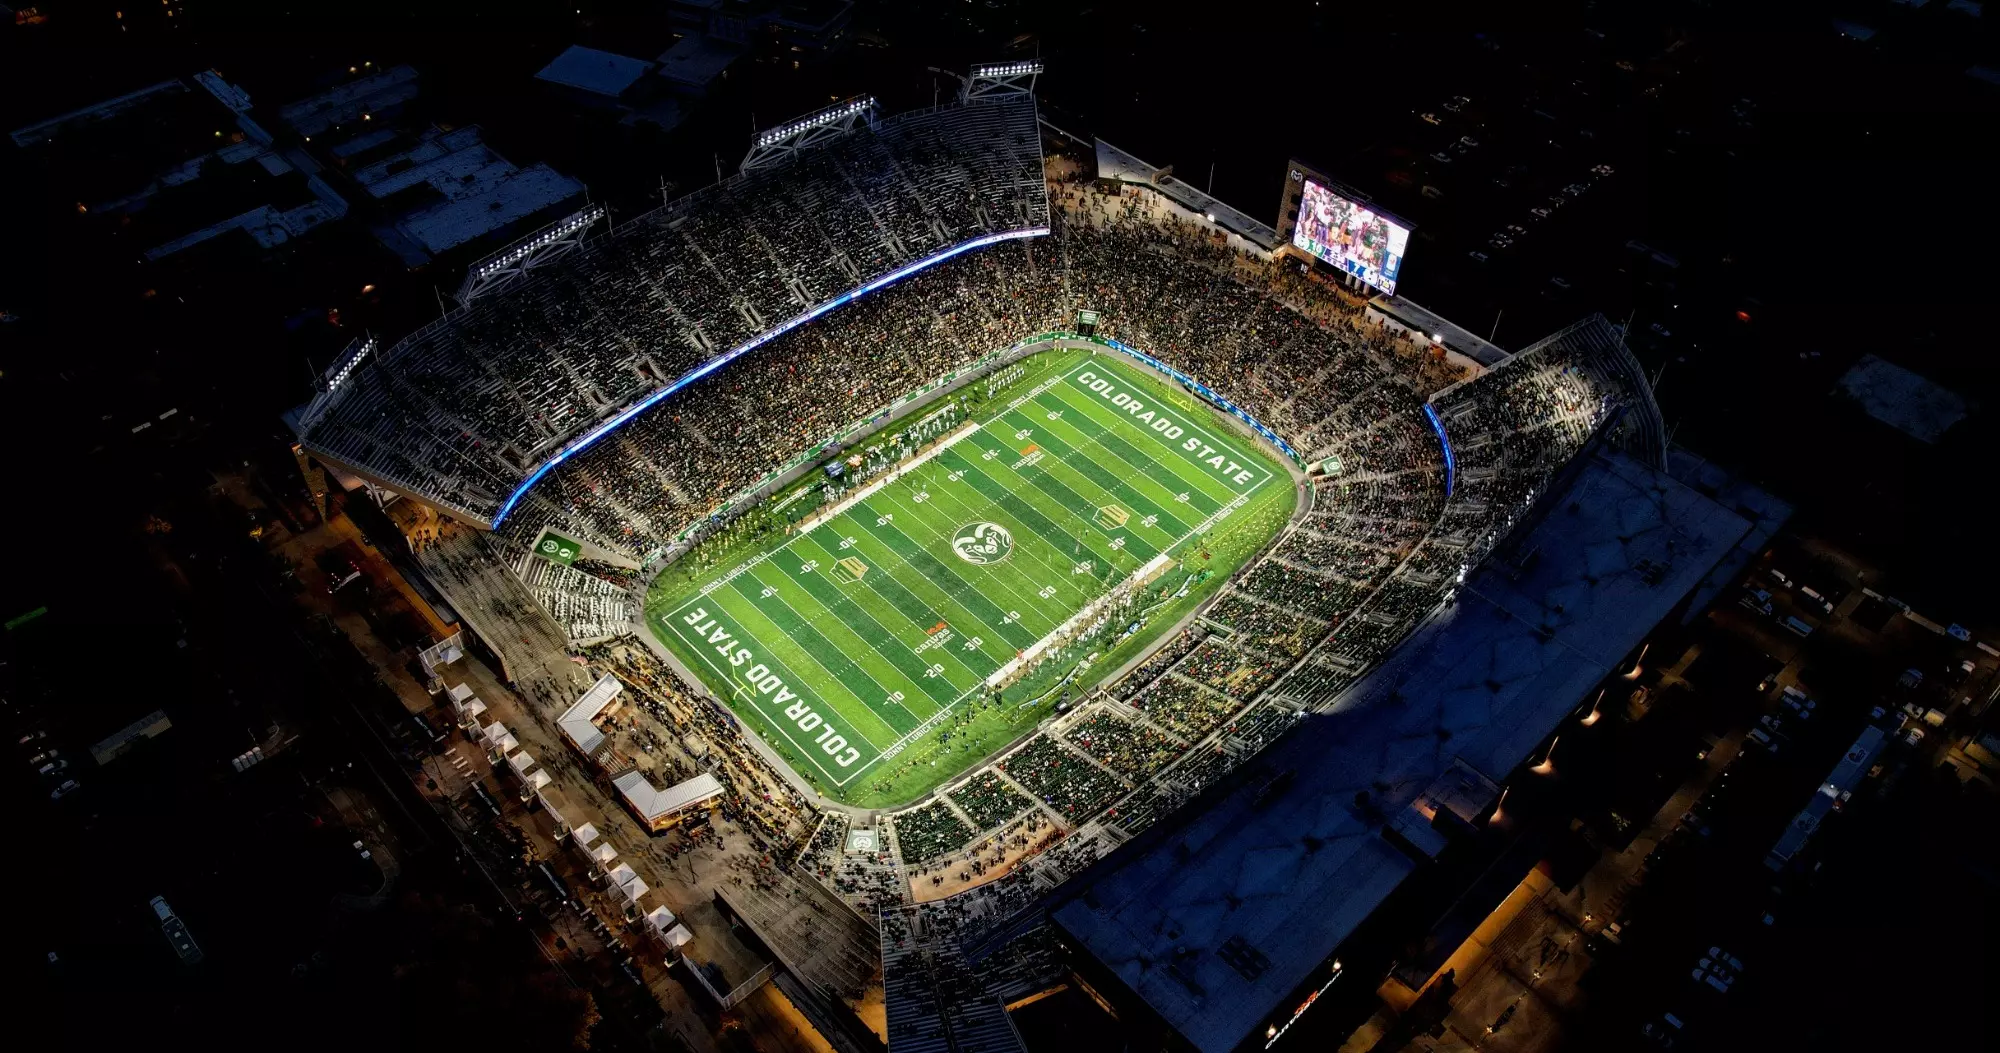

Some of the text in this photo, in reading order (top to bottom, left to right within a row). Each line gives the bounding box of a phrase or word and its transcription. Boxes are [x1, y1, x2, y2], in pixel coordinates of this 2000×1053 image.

[1046, 411, 1062, 421] 10
[1015, 429, 1031, 441] 20
[1077, 371, 1184, 440] COLORADO
[1182, 437, 1254, 485] STATE
[981, 449, 998, 461] 30
[1011, 450, 1041, 470] canvas
[947, 469, 964, 482] 40
[913, 491, 931, 504] 50
[1174, 492, 1190, 503] 10
[876, 513, 894, 526] 40
[1141, 515, 1158, 528] 20
[840, 536, 858, 549] 30
[1108, 538, 1126, 551] 30
[699, 551, 767, 593] SONNY LUBICK FIELD
[802, 559, 820, 573] 20
[1074, 561, 1092, 575] 40
[761, 585, 779, 598] 10
[1038, 585, 1057, 599] 50
[1002, 611, 1021, 625] 40
[914, 628, 950, 653] canvas
[964, 636, 983, 651] 30
[925, 663, 945, 678] 20
[683, 607, 861, 767] COLORADO STATE
[886, 690, 905, 705] 10
[883, 709, 953, 761] SONNY LUBICK FIELD
